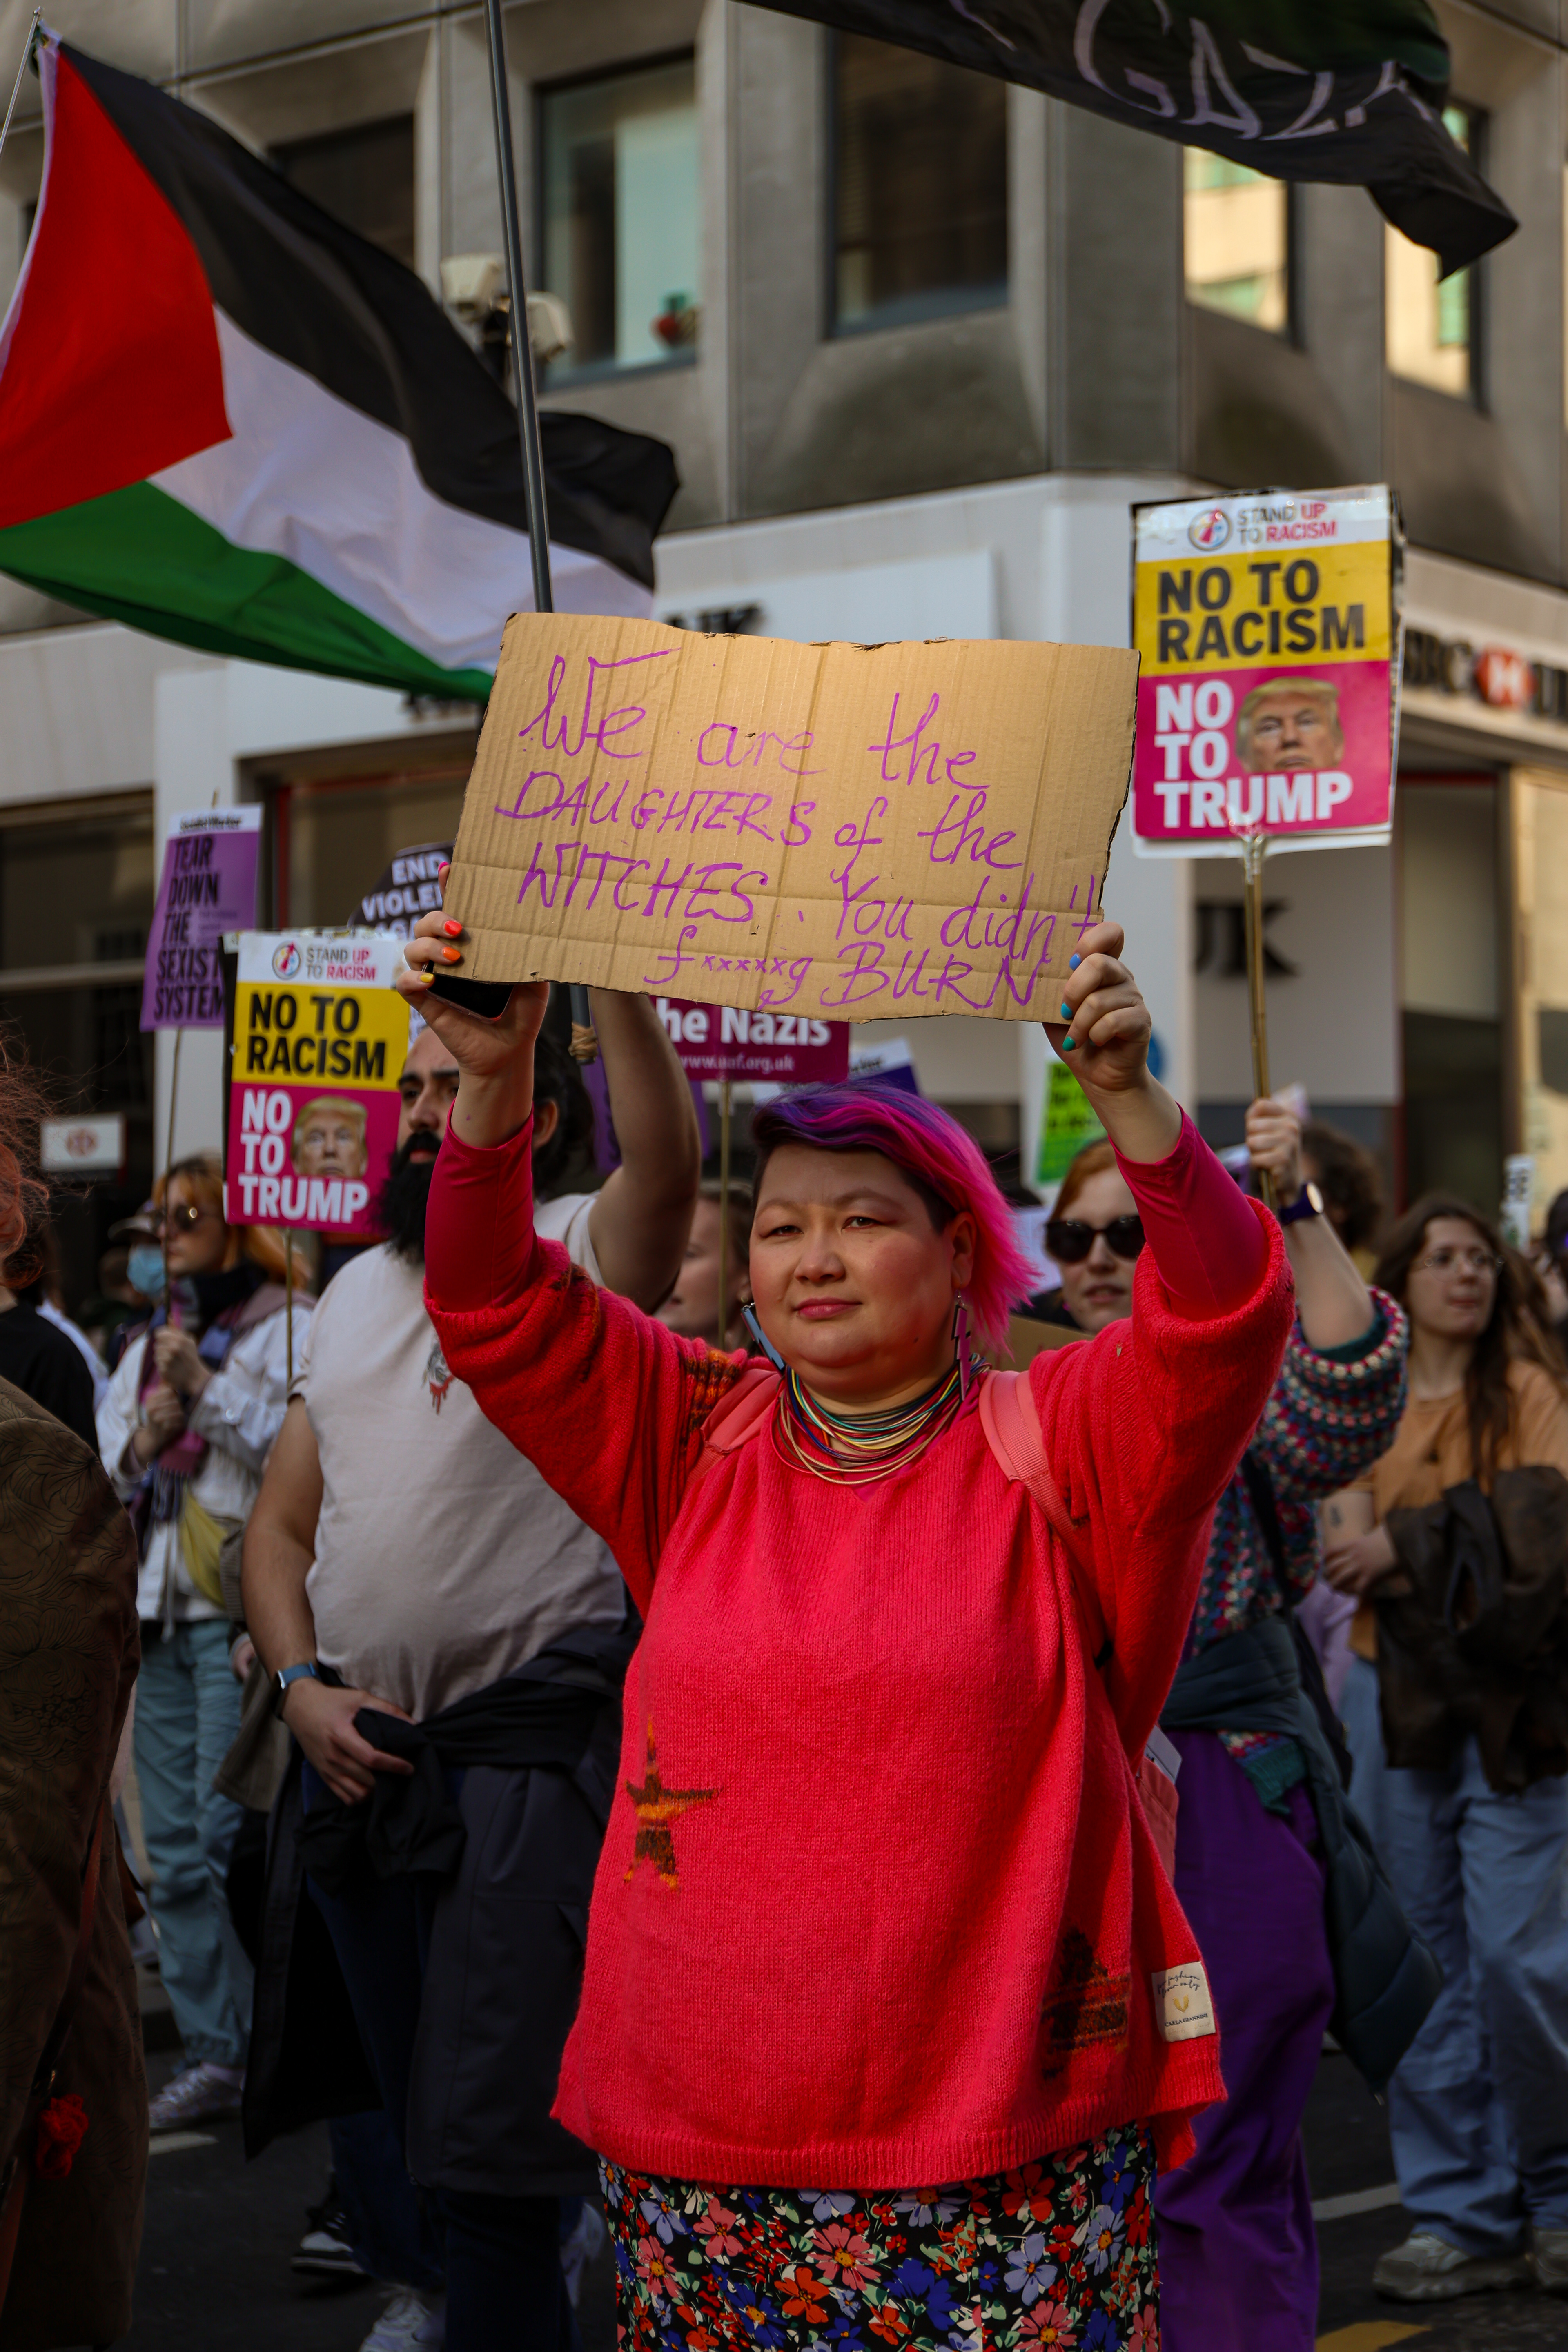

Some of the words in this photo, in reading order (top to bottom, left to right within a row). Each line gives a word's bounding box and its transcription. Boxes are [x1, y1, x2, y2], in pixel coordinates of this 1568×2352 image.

[1237, 506, 1294, 526] STAND
[1301, 503, 1327, 521] UP
[1239, 528, 1263, 545] TO
[1265, 520, 1338, 543] RACISM
[1158, 566, 1232, 615] NO
[1250, 559, 1320, 608] TO
[1158, 604, 1365, 663] RACISM
[519, 647, 681, 760] We
[697, 722, 827, 776] are
[867, 692, 991, 791] the
[1155, 679, 1234, 732] NO
[1154, 731, 1229, 781] TO
[1153, 770, 1353, 829] TRUMP
[494, 771, 816, 847] DAUGHTERS
[833, 795, 889, 876] of
[917, 790, 1023, 870] the
[174, 837, 213, 871] TEAR
[391, 851, 448, 887] END
[169, 874, 219, 906] DOWN
[162, 911, 191, 944] THE
[830, 868, 915, 942] You
[939, 873, 1101, 964] didn't
[156, 947, 220, 982] SEXIST
[306, 948, 349, 964] STAND
[352, 948, 370, 964] UP
[306, 964, 323, 979] TO
[326, 964, 376, 981] RACISM
[818, 941, 1053, 1010] BURN
[153, 984, 225, 1021] SYSTEM
[249, 992, 298, 1031] NO
[310, 995, 360, 1035] TO
[656, 998, 711, 1044] he
[720, 1007, 831, 1046] Nazis
[247, 1035, 387, 1080] RACISM
[242, 1089, 292, 1134] NO
[240, 1131, 286, 1177] TO
[238, 1173, 369, 1224] TRUMP
[1164, 2019, 1183, 2027] CARLA
